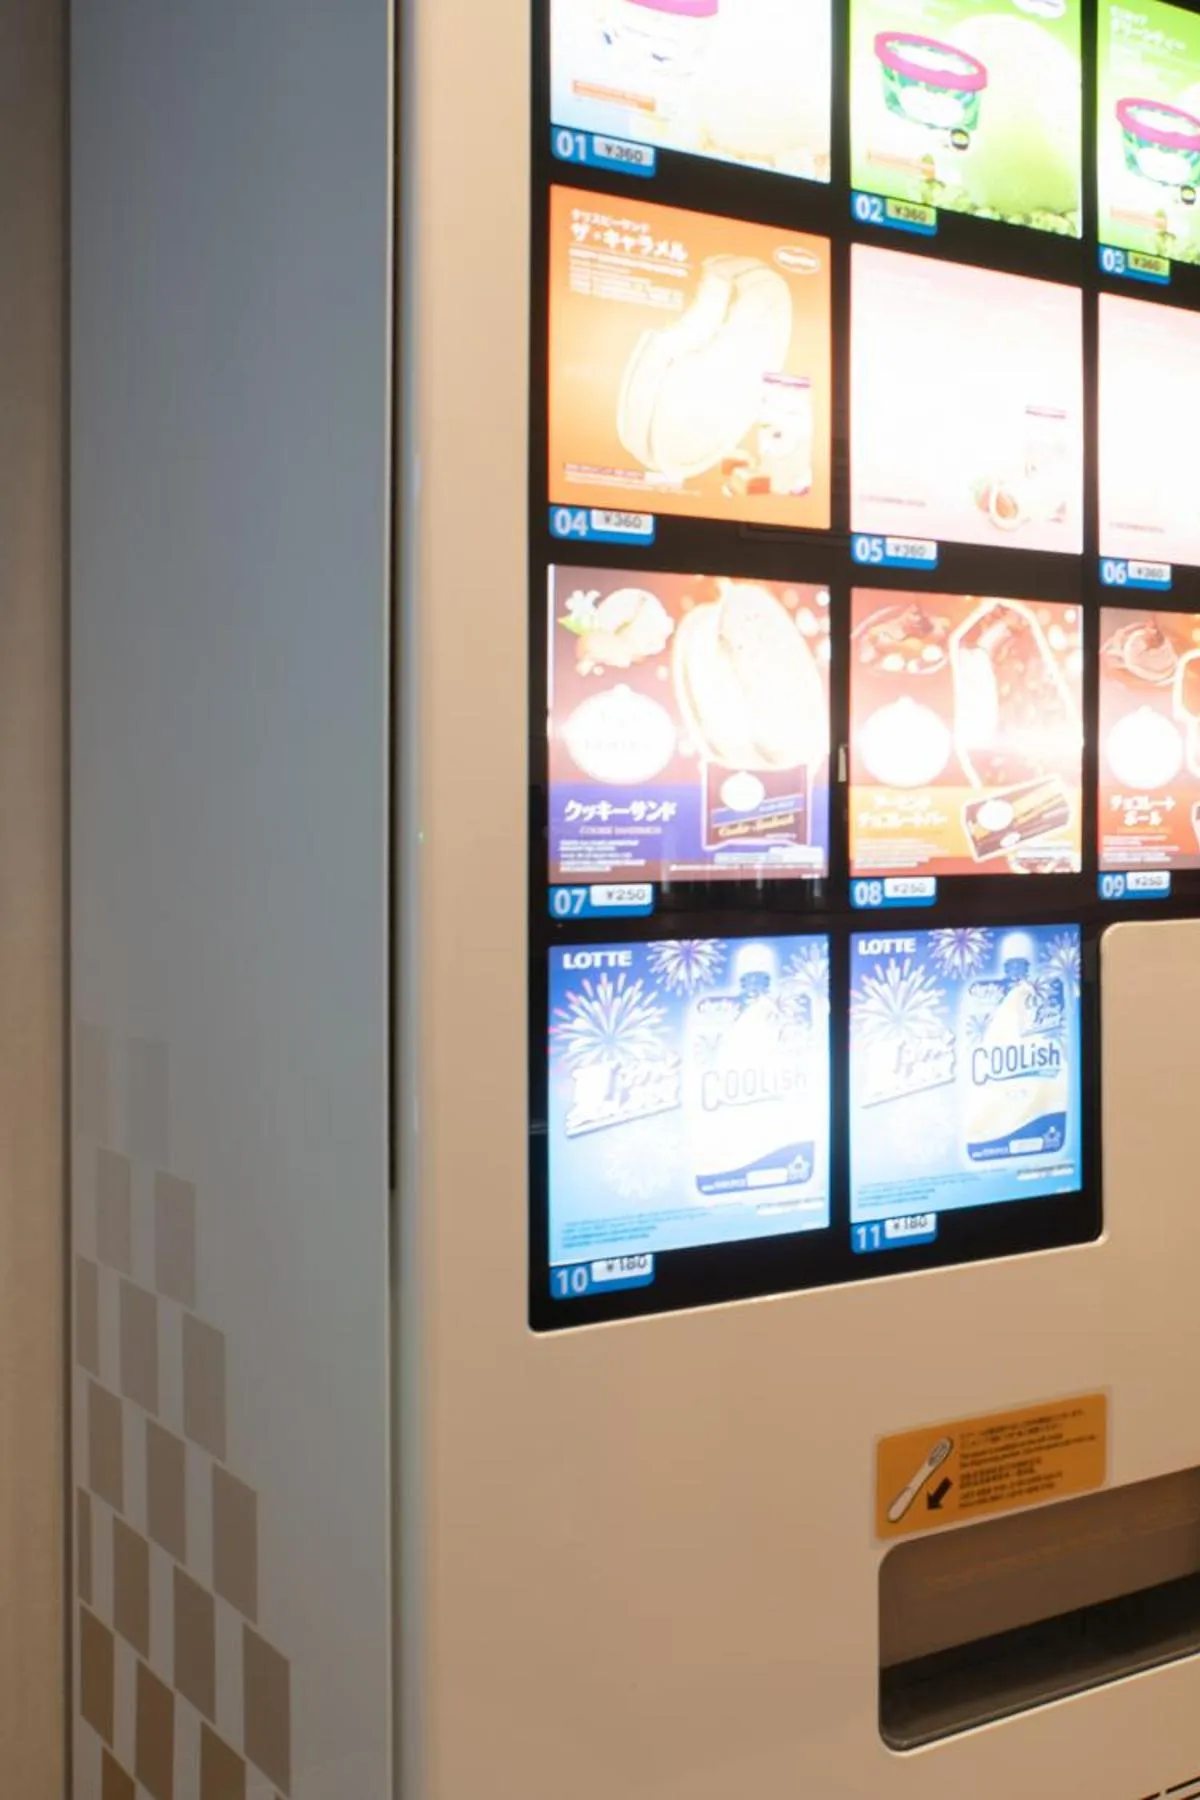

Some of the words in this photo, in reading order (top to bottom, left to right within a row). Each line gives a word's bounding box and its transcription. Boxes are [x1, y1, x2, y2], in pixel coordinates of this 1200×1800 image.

[555, 130, 586, 161] 01
[855, 194, 884, 223] 02
[571, 222, 689, 263] ザ・キャラメル
[1102, 249, 1125, 274] 03
[554, 509, 588, 537] 04
[603, 514, 642, 530] ¥360
[855, 536, 883, 563] 05
[1102, 561, 1128, 585] 06
[563, 799, 678, 823] クッキーサンド
[606, 888, 646, 902] ¥250
[855, 881, 884, 906] 08
[1102, 875, 1125, 898] 09
[554, 888, 588, 915] 07
[858, 937, 917, 956] LOTTE
[563, 950, 633, 970] LOTTE
[971, 1043, 1061, 1086] COOLish
[701, 1063, 808, 1113] COOLish
[857, 1224, 881, 1251] 11
[607, 1256, 647, 1272] ¥180
[556, 1267, 588, 1295] 10
